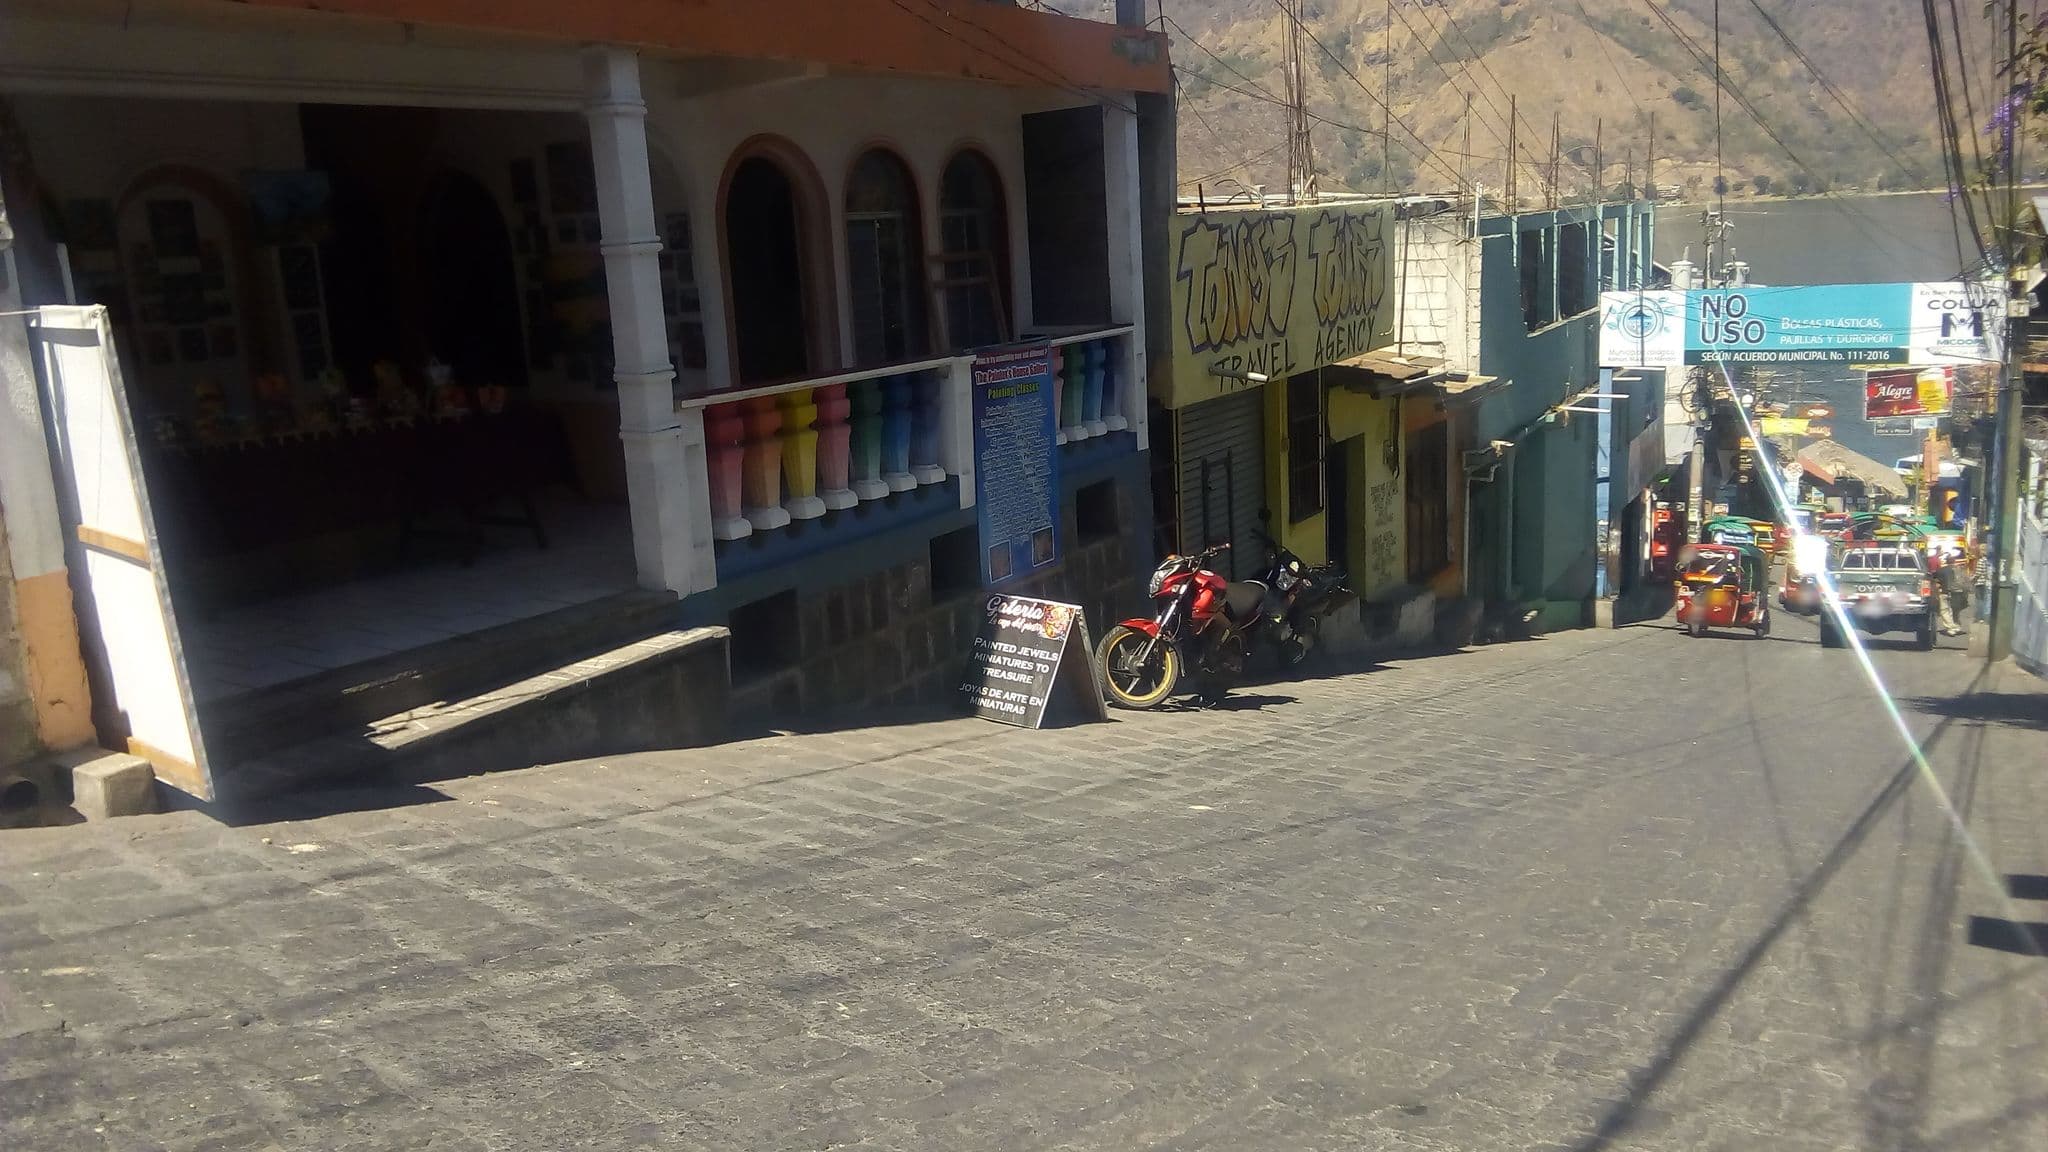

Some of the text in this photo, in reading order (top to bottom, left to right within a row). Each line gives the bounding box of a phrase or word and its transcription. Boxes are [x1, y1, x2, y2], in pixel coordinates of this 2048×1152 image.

[1701, 294, 1747, 319] NO
[1927, 299, 2004, 310] COLUA
[1701, 319, 1766, 345] USO
[1825, 317, 1882, 328] PLÁSTICAS,
[1780, 335, 1823, 344] PAJILLAS
[1827, 335, 1834, 343] Y
[1214, 316, 1375, 392] TRAVEL AGENCY
[1701, 350, 1889, 362] SEGÚN ACUERDO MUNICIPAL No. 111-2016
[1874, 384, 1912, 399] Alegre
[974, 638, 1059, 661] PAINTED JEWELS
[974, 652, 1049, 673] MINIATURES TO
[982, 667, 1034, 684] TREASURE
[959, 683, 1043, 706] JOYAS DE ARTE EN
[970, 696, 1026, 715] MINIATURAS
